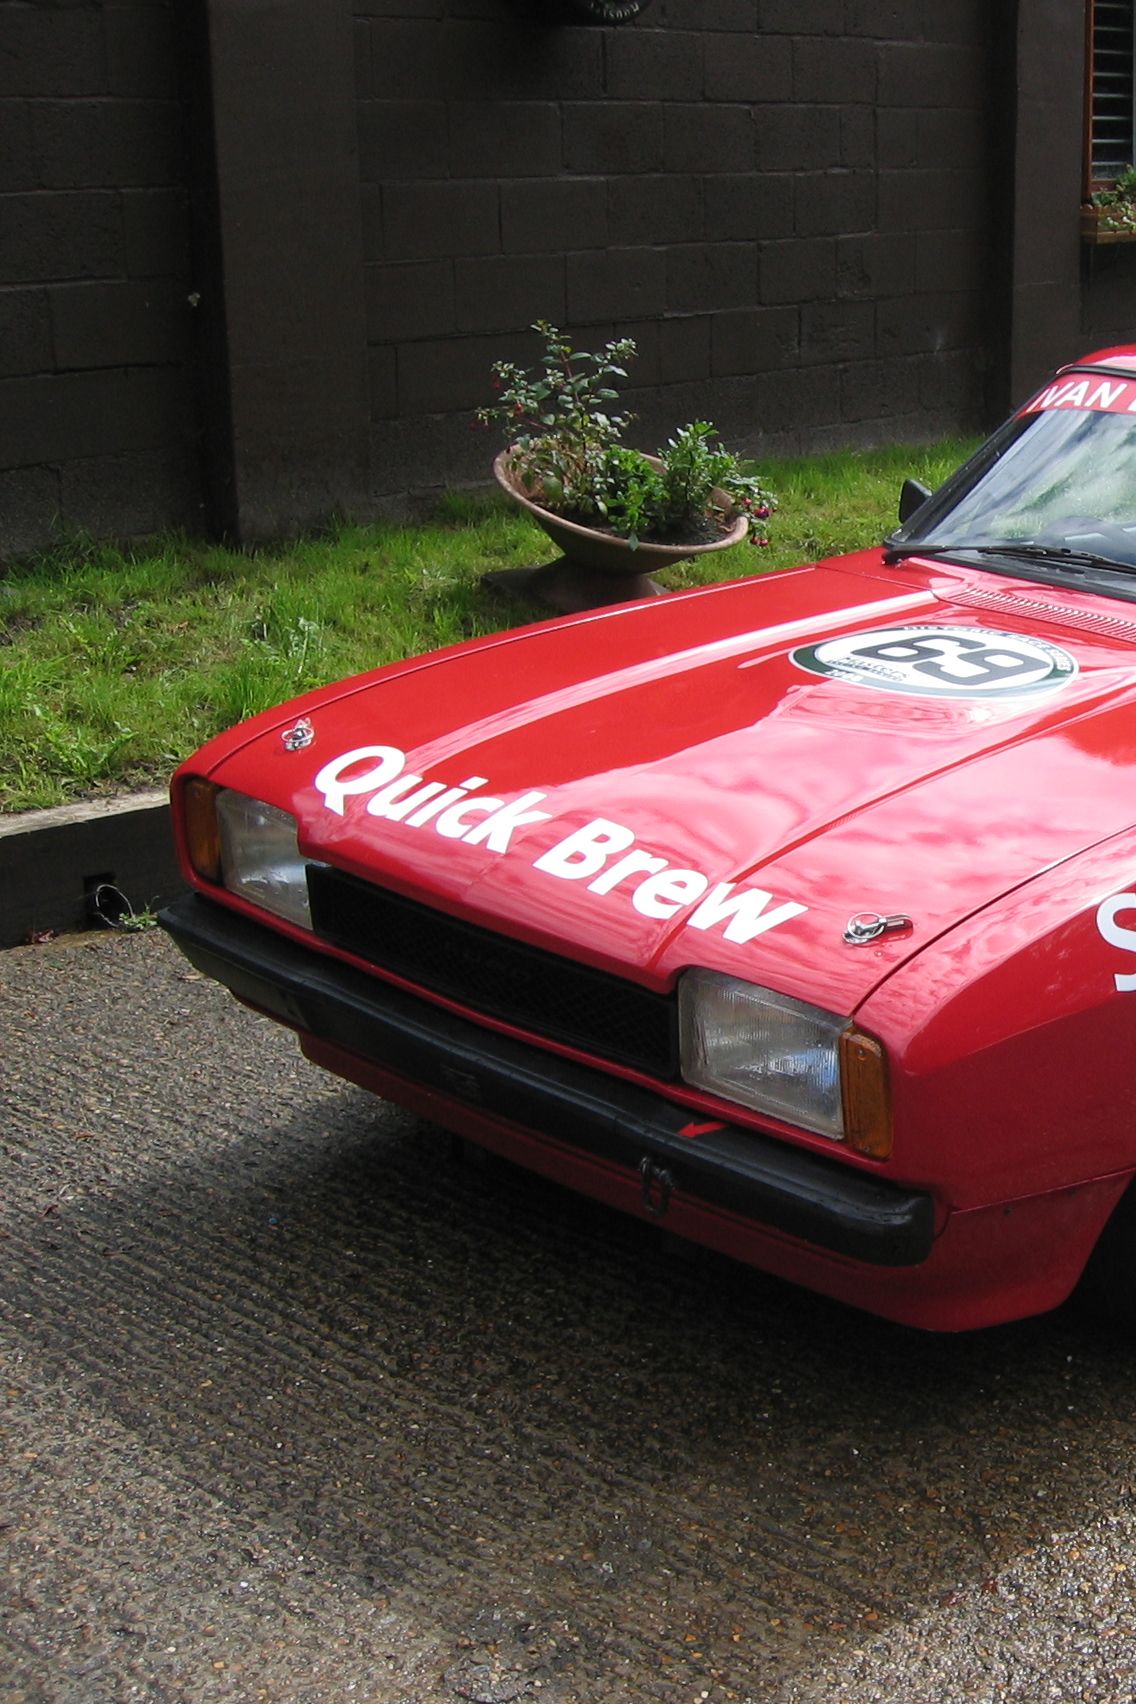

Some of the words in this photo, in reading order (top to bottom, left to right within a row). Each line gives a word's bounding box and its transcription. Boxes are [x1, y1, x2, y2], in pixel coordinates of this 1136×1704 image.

[1026, 381, 1127, 412] IVAN
[851, 634, 1052, 687] 69
[315, 745, 553, 855] Quick
[532, 816, 809, 945] Brew
